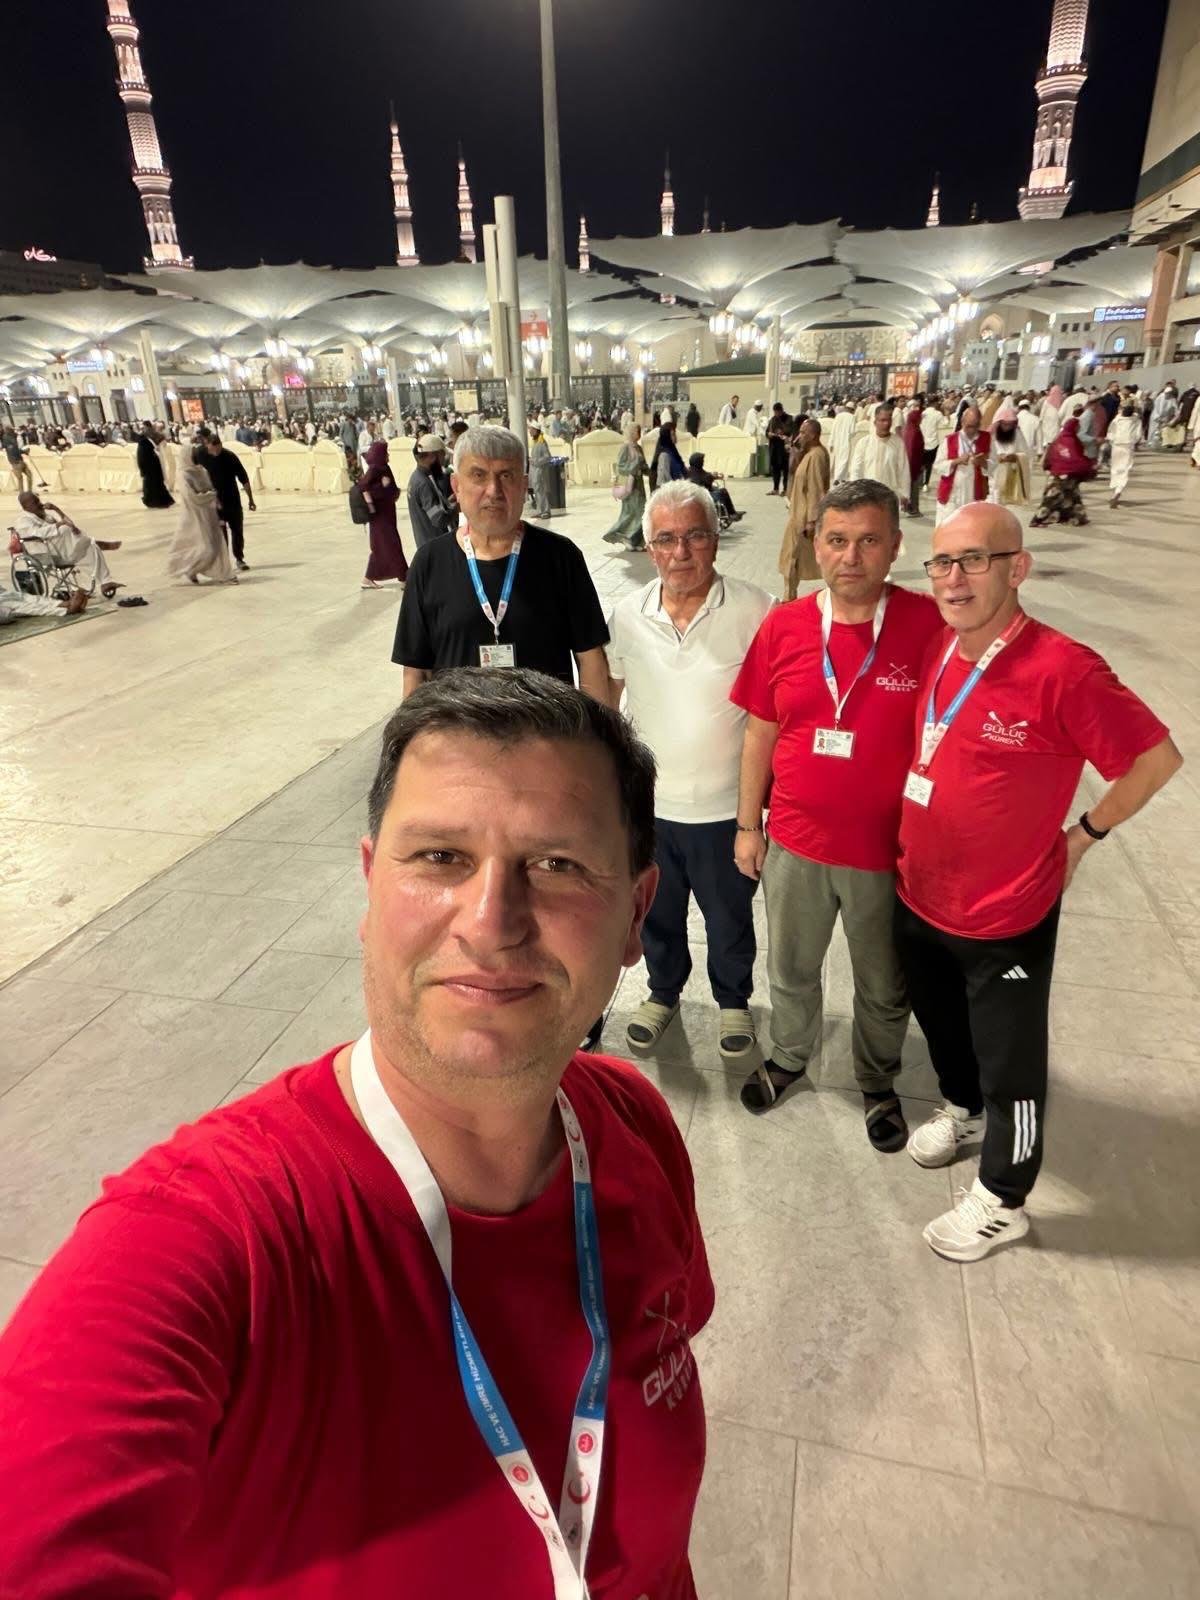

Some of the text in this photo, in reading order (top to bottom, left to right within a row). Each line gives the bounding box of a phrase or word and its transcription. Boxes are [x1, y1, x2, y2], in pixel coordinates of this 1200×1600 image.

[983, 723, 1027, 741] GÜLÜÇ
[488, 1412, 500, 1426] VE
[495, 1425, 510, 1447] HAC
